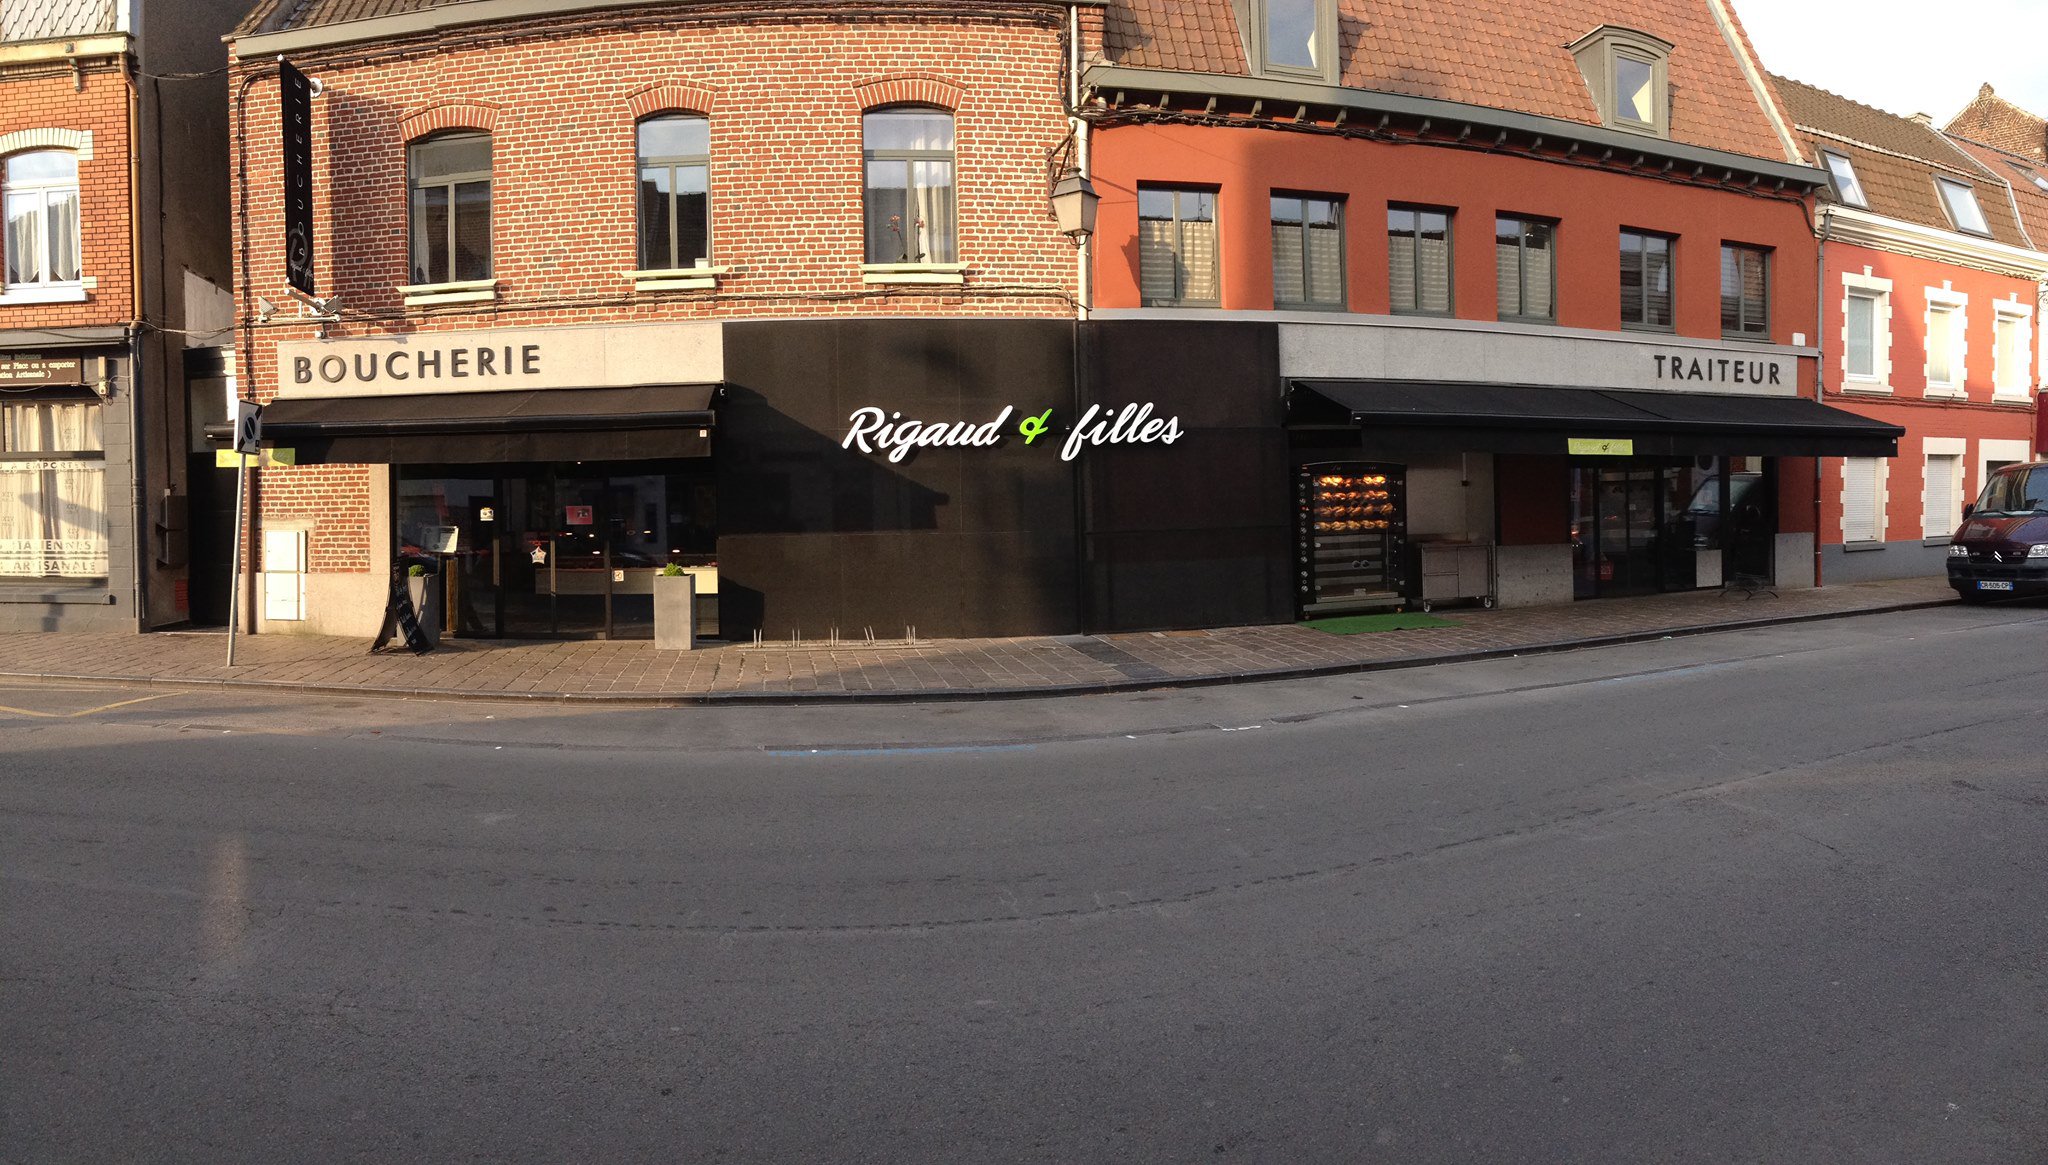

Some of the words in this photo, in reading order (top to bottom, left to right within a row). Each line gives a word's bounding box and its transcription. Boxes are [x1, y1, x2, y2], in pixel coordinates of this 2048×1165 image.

[294, 77, 305, 256] BOUCHERIE
[294, 344, 541, 384] BOUCHERIE
[1654, 355, 1780, 385] TRAITEUR
[841, 404, 1014, 463] Rigaud
[1060, 402, 1184, 461] filles
[13, 540, 92, 550] TAENNES
[13, 560, 95, 571] ARISANALE
